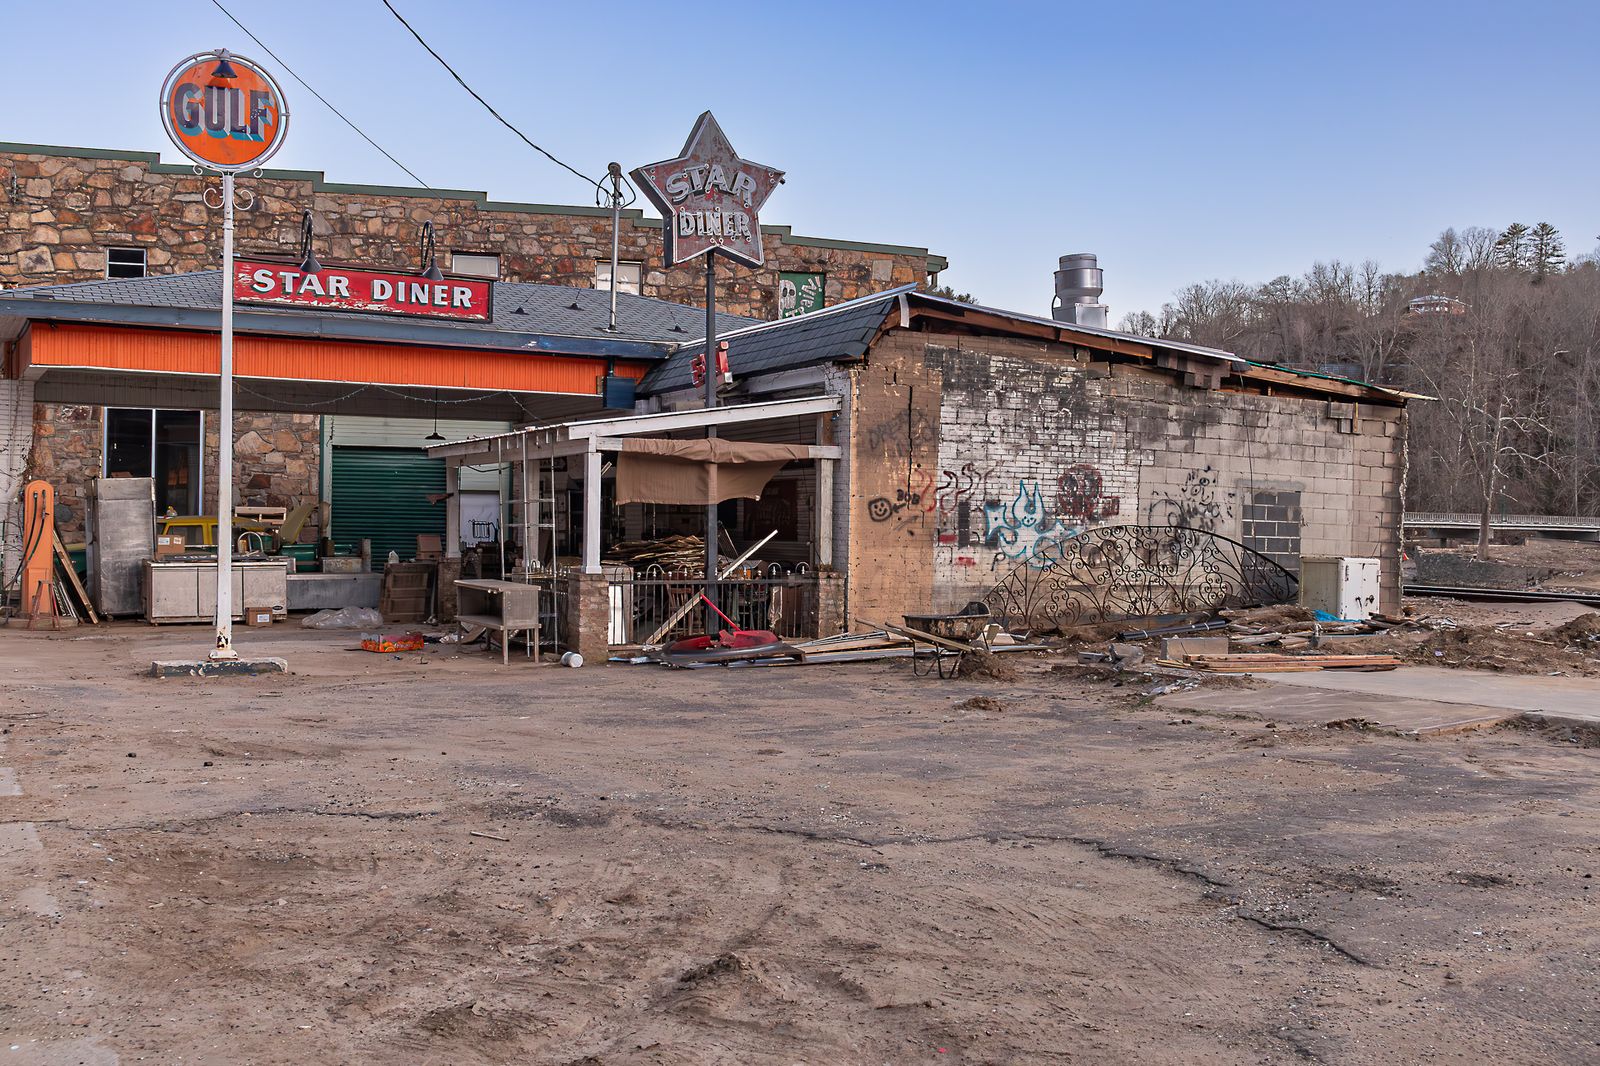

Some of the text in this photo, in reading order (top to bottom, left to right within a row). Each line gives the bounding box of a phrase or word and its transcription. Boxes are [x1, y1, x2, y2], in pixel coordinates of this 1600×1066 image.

[174, 82, 274, 142] GULF
[666, 164, 757, 208] STAR
[679, 208, 752, 242] DINER
[252, 269, 473, 308] STAR DINER
